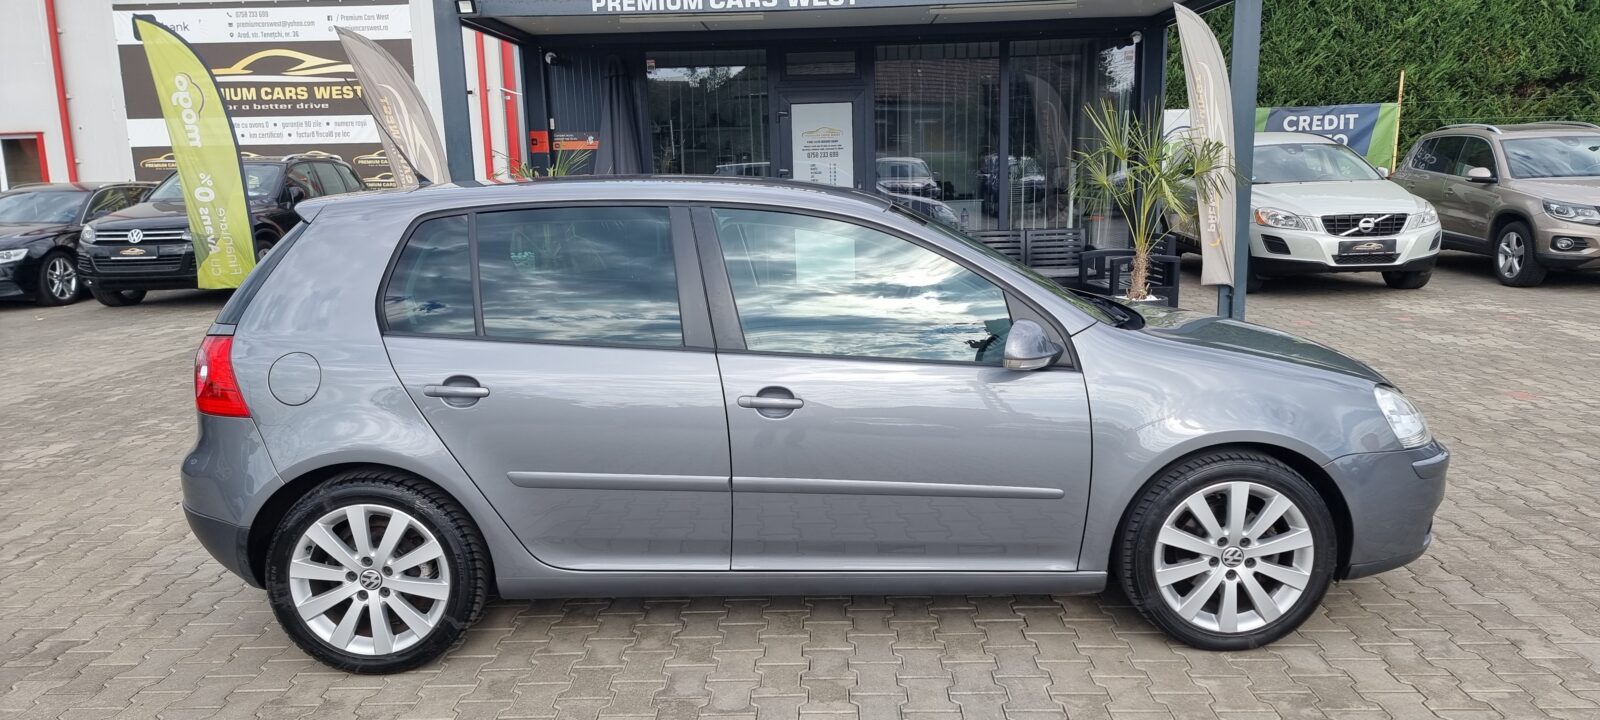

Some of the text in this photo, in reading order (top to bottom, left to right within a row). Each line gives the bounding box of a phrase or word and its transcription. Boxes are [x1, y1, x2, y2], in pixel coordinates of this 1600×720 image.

[261, 86, 308, 100] CARS
[314, 85, 362, 100] WEST
[1283, 113, 1359, 132] CREDIT
